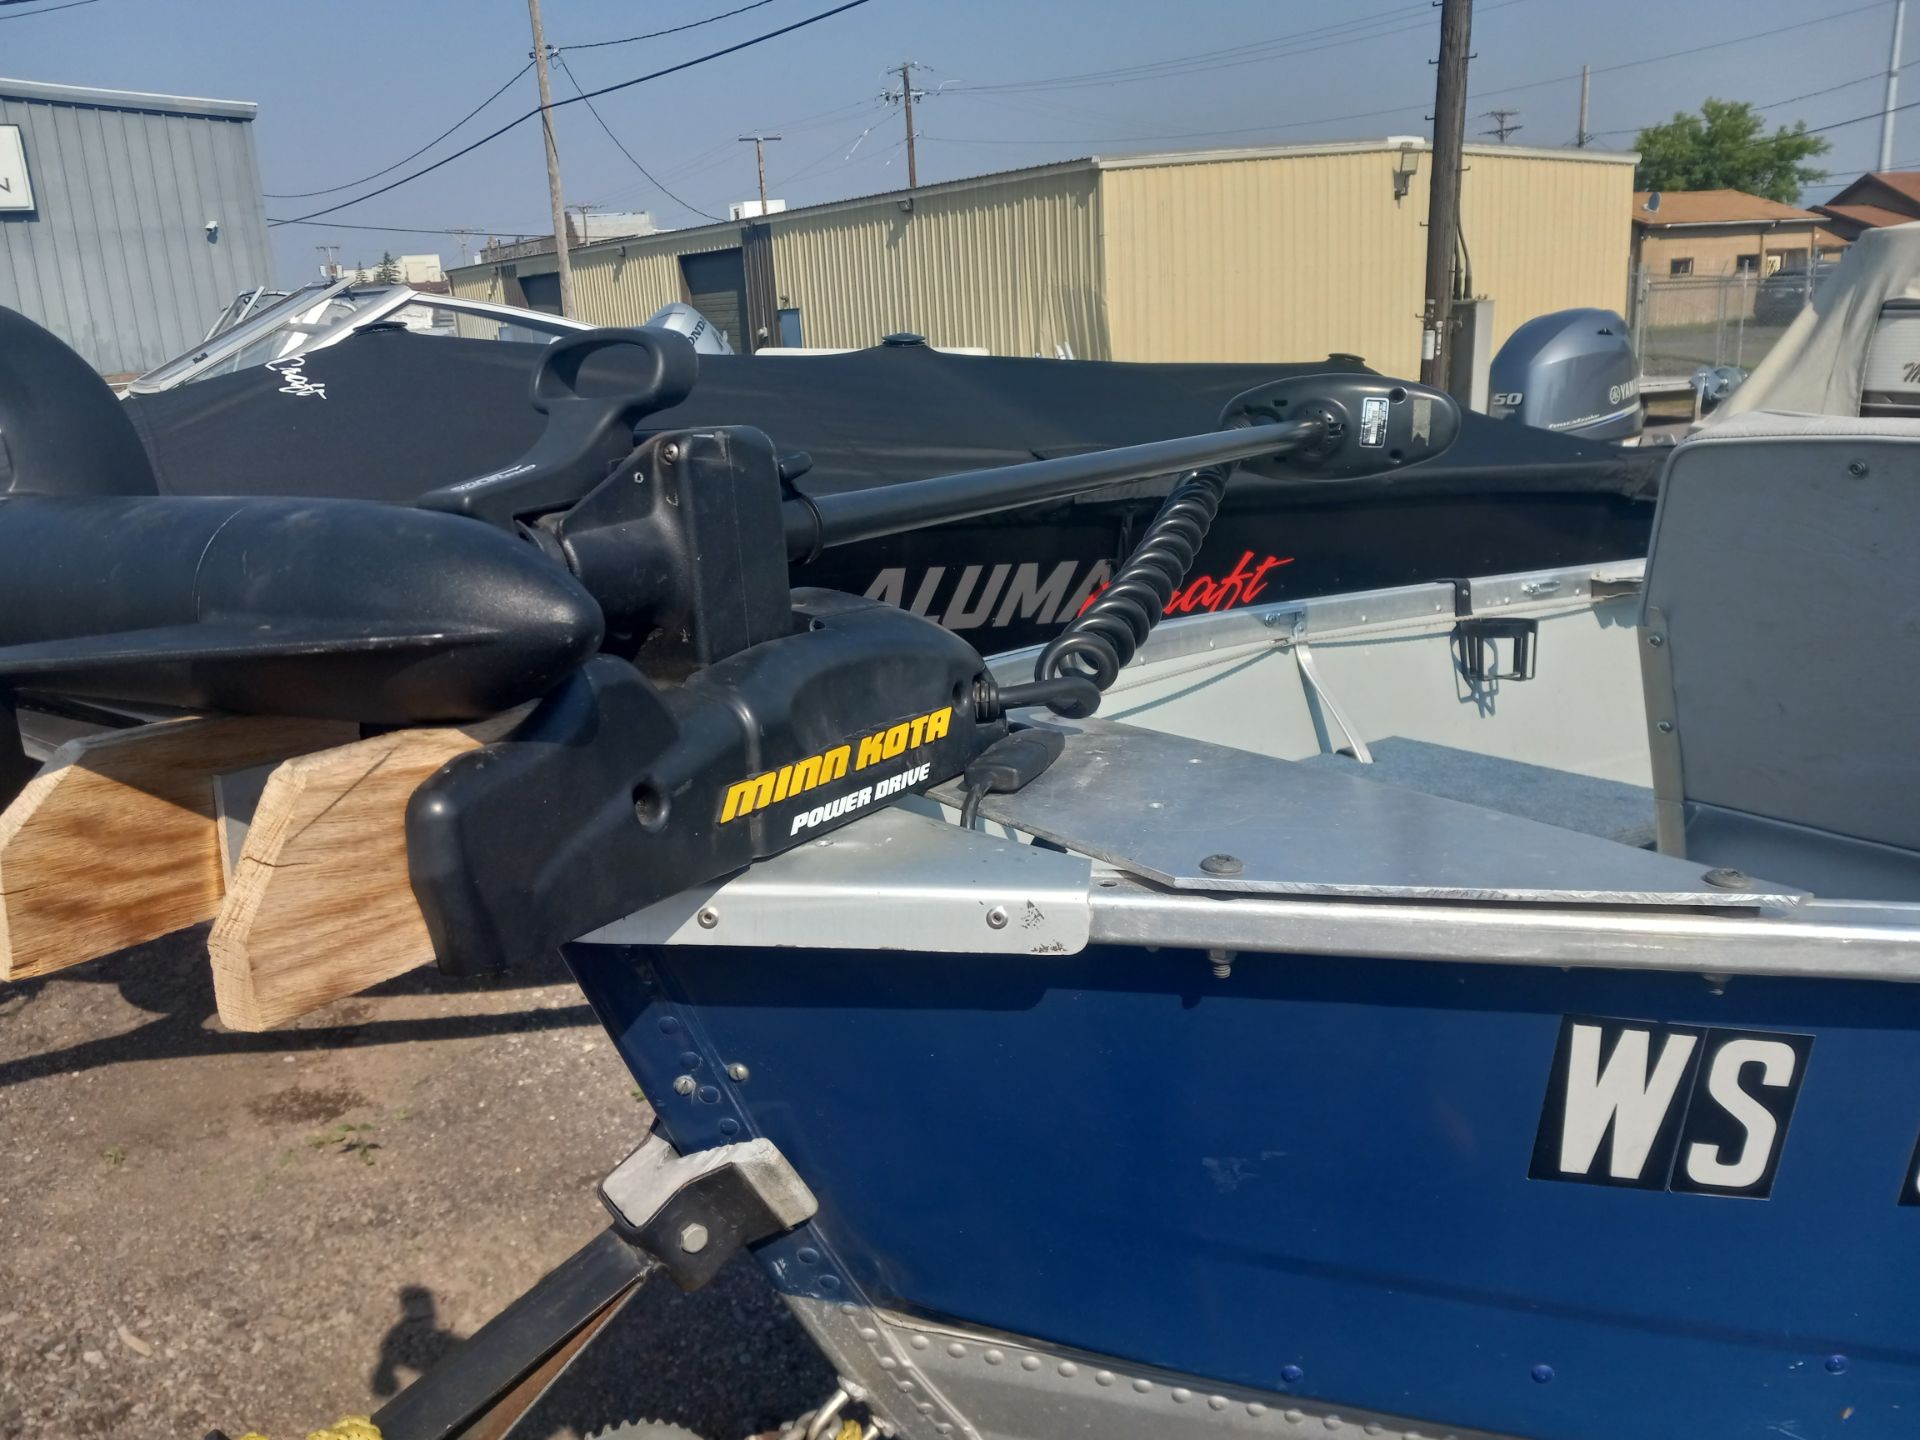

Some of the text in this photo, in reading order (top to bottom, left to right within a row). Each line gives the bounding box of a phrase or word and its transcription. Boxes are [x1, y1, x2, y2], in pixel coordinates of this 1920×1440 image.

[1493, 392, 1523, 406] 50
[720, 706, 952, 824] MINN KOTA
[790, 762, 931, 836] POWER DRIVE
[1560, 1024, 1796, 1187] WS
